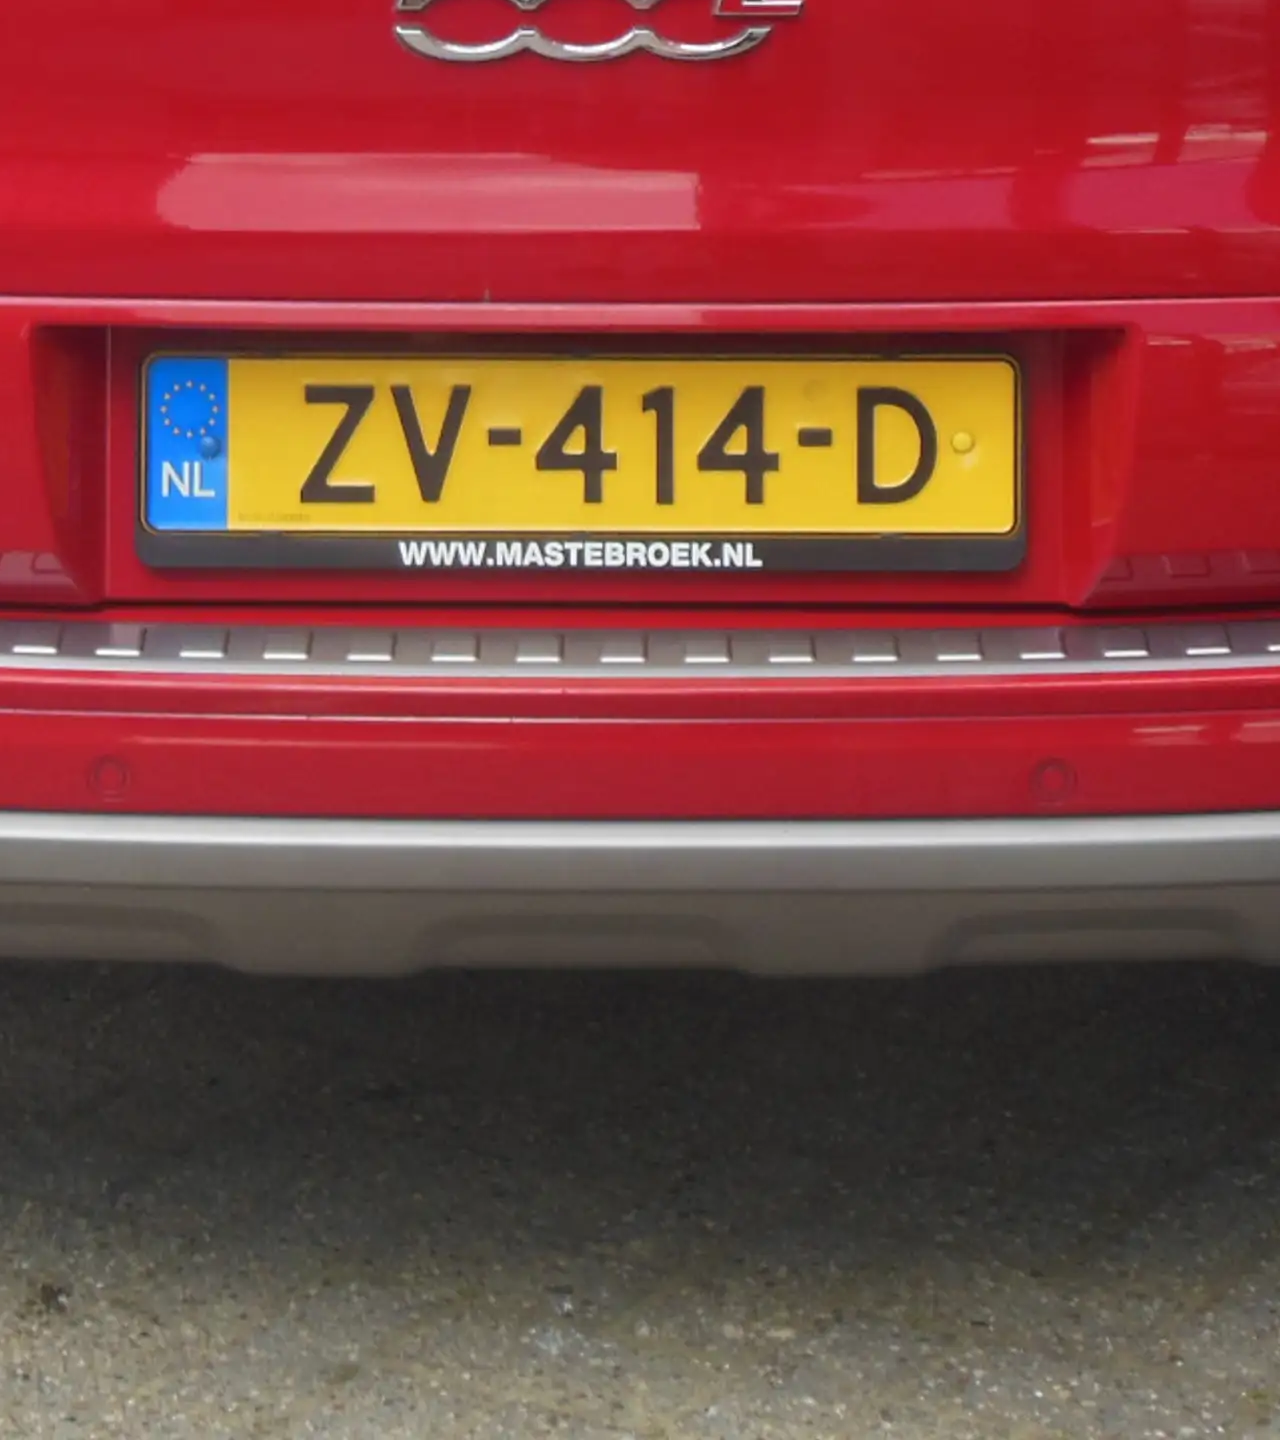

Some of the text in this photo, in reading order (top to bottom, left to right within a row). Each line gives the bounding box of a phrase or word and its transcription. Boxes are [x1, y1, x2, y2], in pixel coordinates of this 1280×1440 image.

[299, 384, 939, 506] ZV-414-D
[161, 460, 217, 498] NL
[398, 540, 764, 568] WWW.MASTEBROEK.NL
